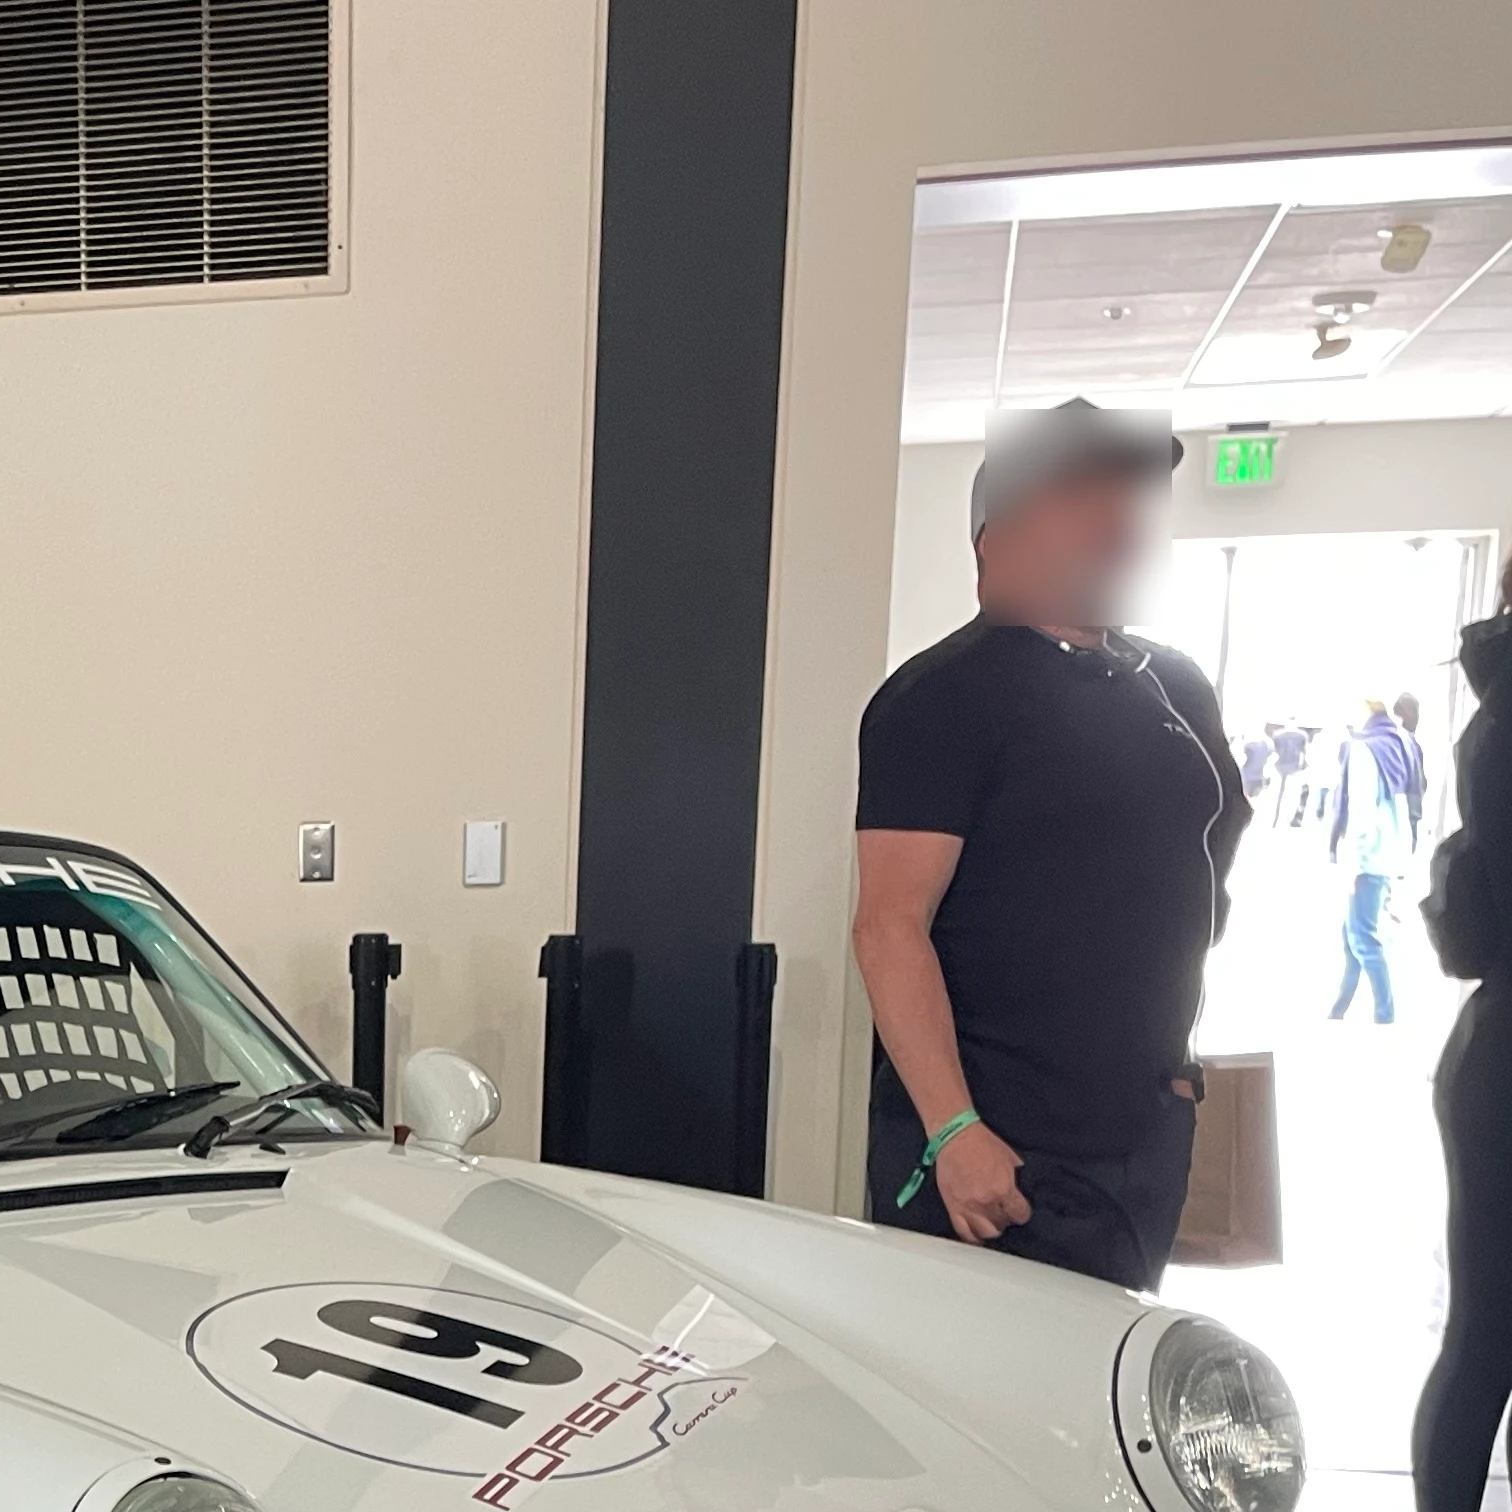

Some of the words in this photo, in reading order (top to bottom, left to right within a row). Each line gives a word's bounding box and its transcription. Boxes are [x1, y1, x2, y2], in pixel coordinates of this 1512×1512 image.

[1216, 438, 1273, 483] EXIT
[260, 1300, 583, 1432] 19
[472, 1345, 695, 1512] PORSCHE
